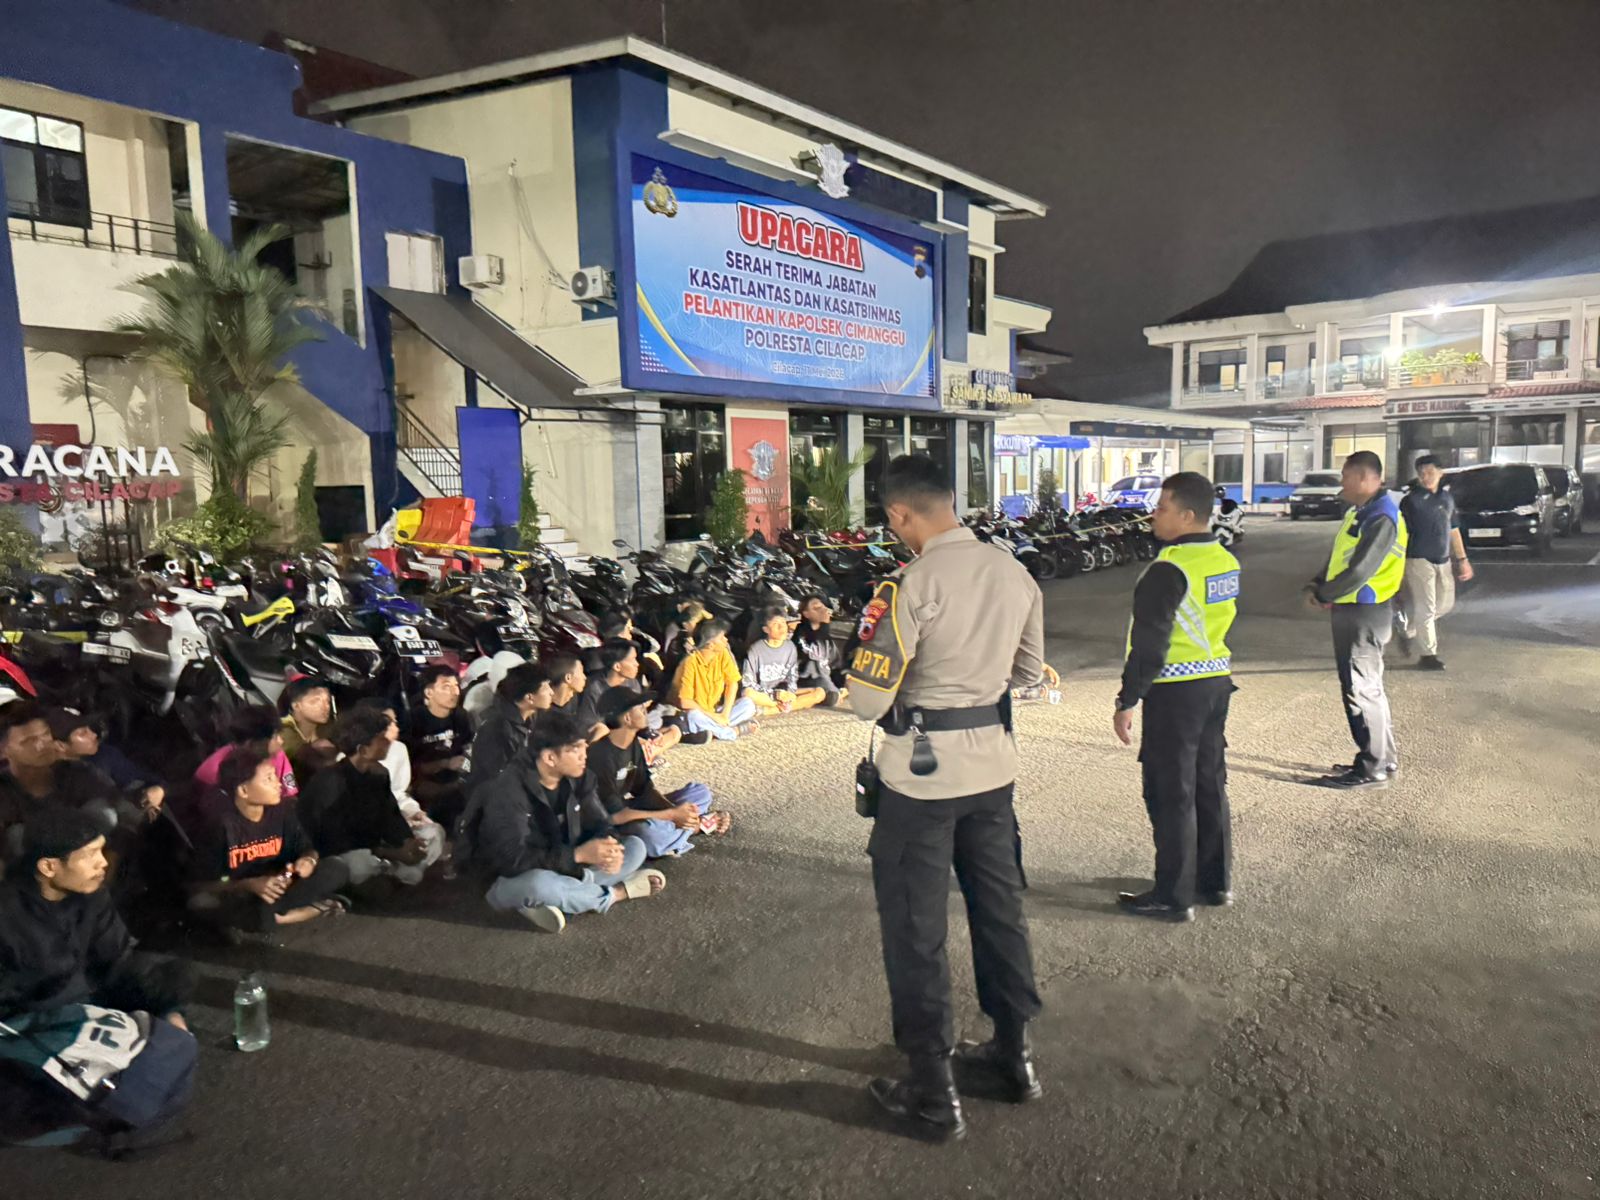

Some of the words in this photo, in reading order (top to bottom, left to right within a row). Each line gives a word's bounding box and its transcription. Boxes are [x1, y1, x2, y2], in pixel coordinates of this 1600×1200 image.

[737, 202, 865, 271] UPACARA
[689, 267, 791, 305] KASATLANTAS
[794, 289, 821, 310] DAN
[824, 296, 902, 325] KASATBINMAS
[726, 250, 772, 277] SERAH
[775, 262, 822, 287] TERIMA
[826, 274, 877, 299] JABATAN
[683, 292, 775, 325] PELANTIKAN
[778, 311, 842, 337] KAPOLSEK
[845, 322, 906, 346] CIMANGGU
[745, 328, 812, 354] POLRESTA
[815, 341, 866, 361] CILACAP
[0, 444, 181, 477] RACANA
[64, 478, 184, 501] CILACAP
